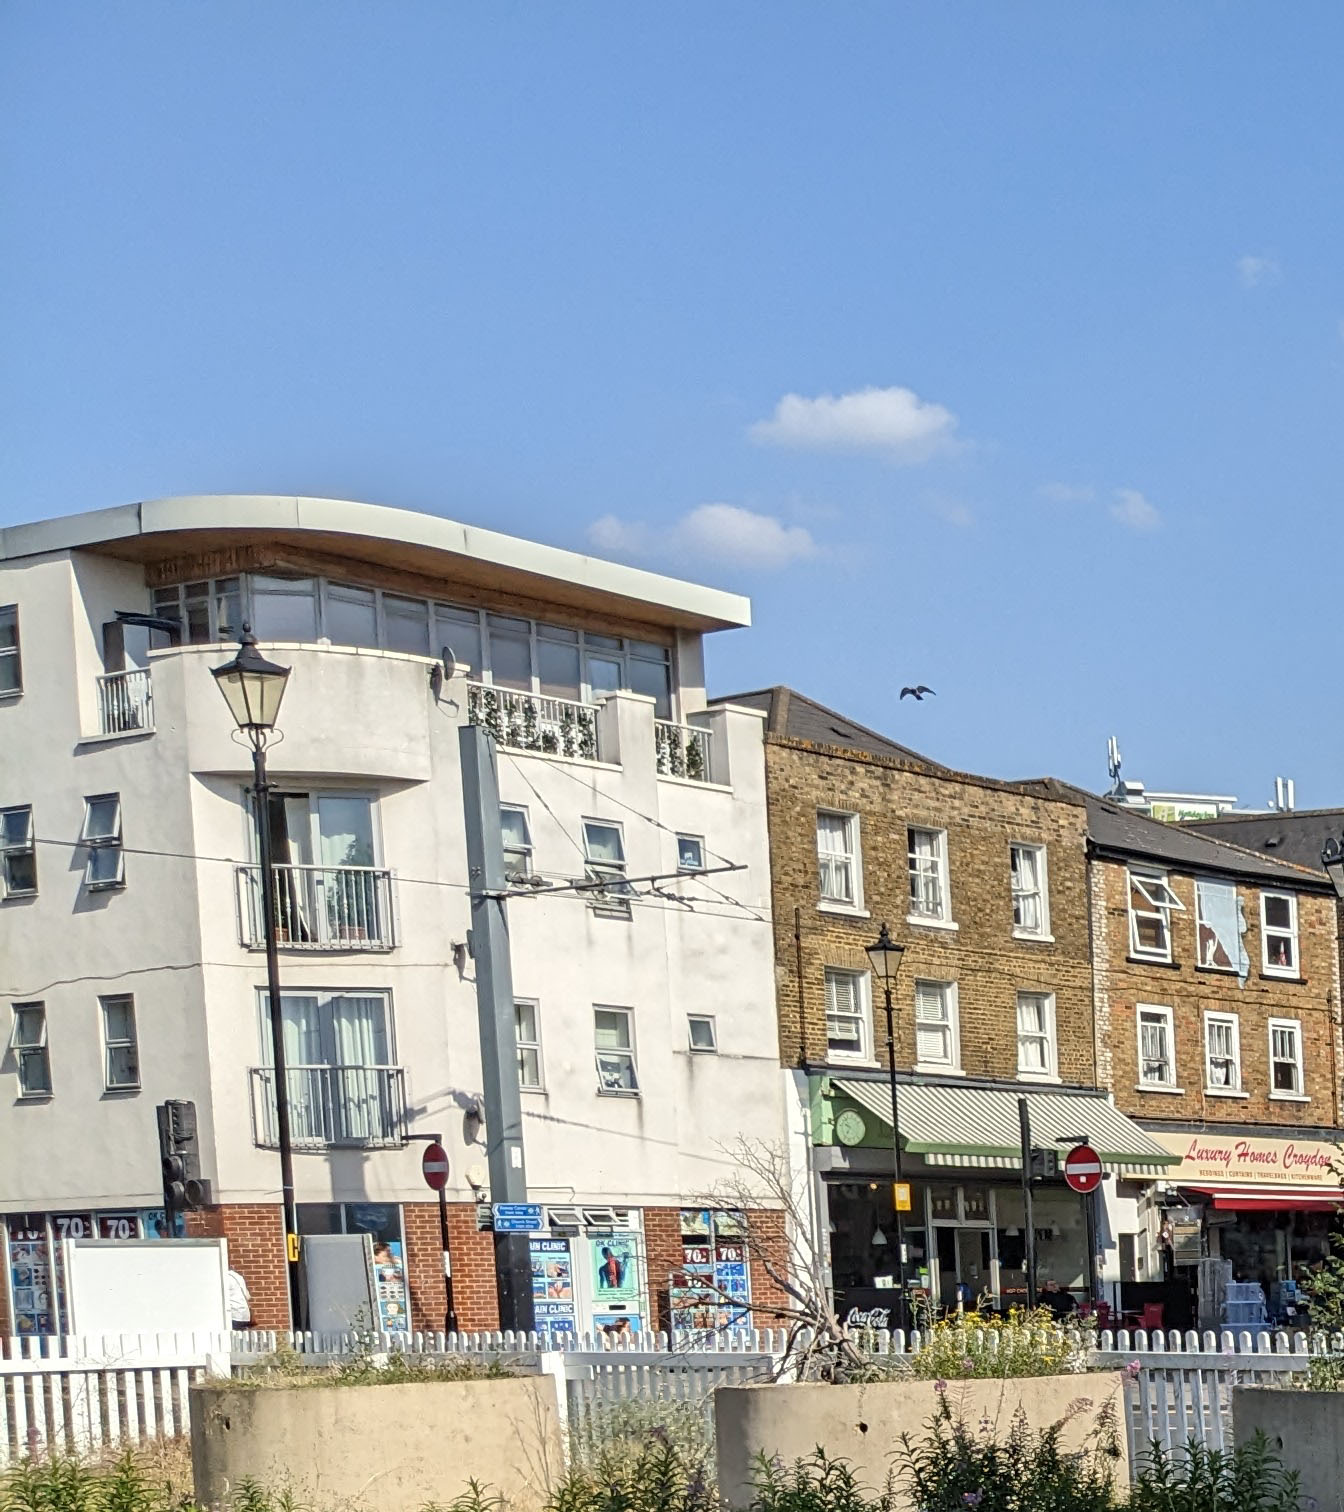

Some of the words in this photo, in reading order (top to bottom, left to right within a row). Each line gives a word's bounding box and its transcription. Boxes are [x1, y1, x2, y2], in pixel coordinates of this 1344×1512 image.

[1184, 1138, 1233, 1168] Luxury
[1234, 1141, 1278, 1164] Homes
[541, 1241, 567, 1251] CLINIC
[534, 1305, 548, 1314] AIN
[548, 1304, 574, 1314] CLINIC
[847, 1306, 892, 1329] Coca-Cola
